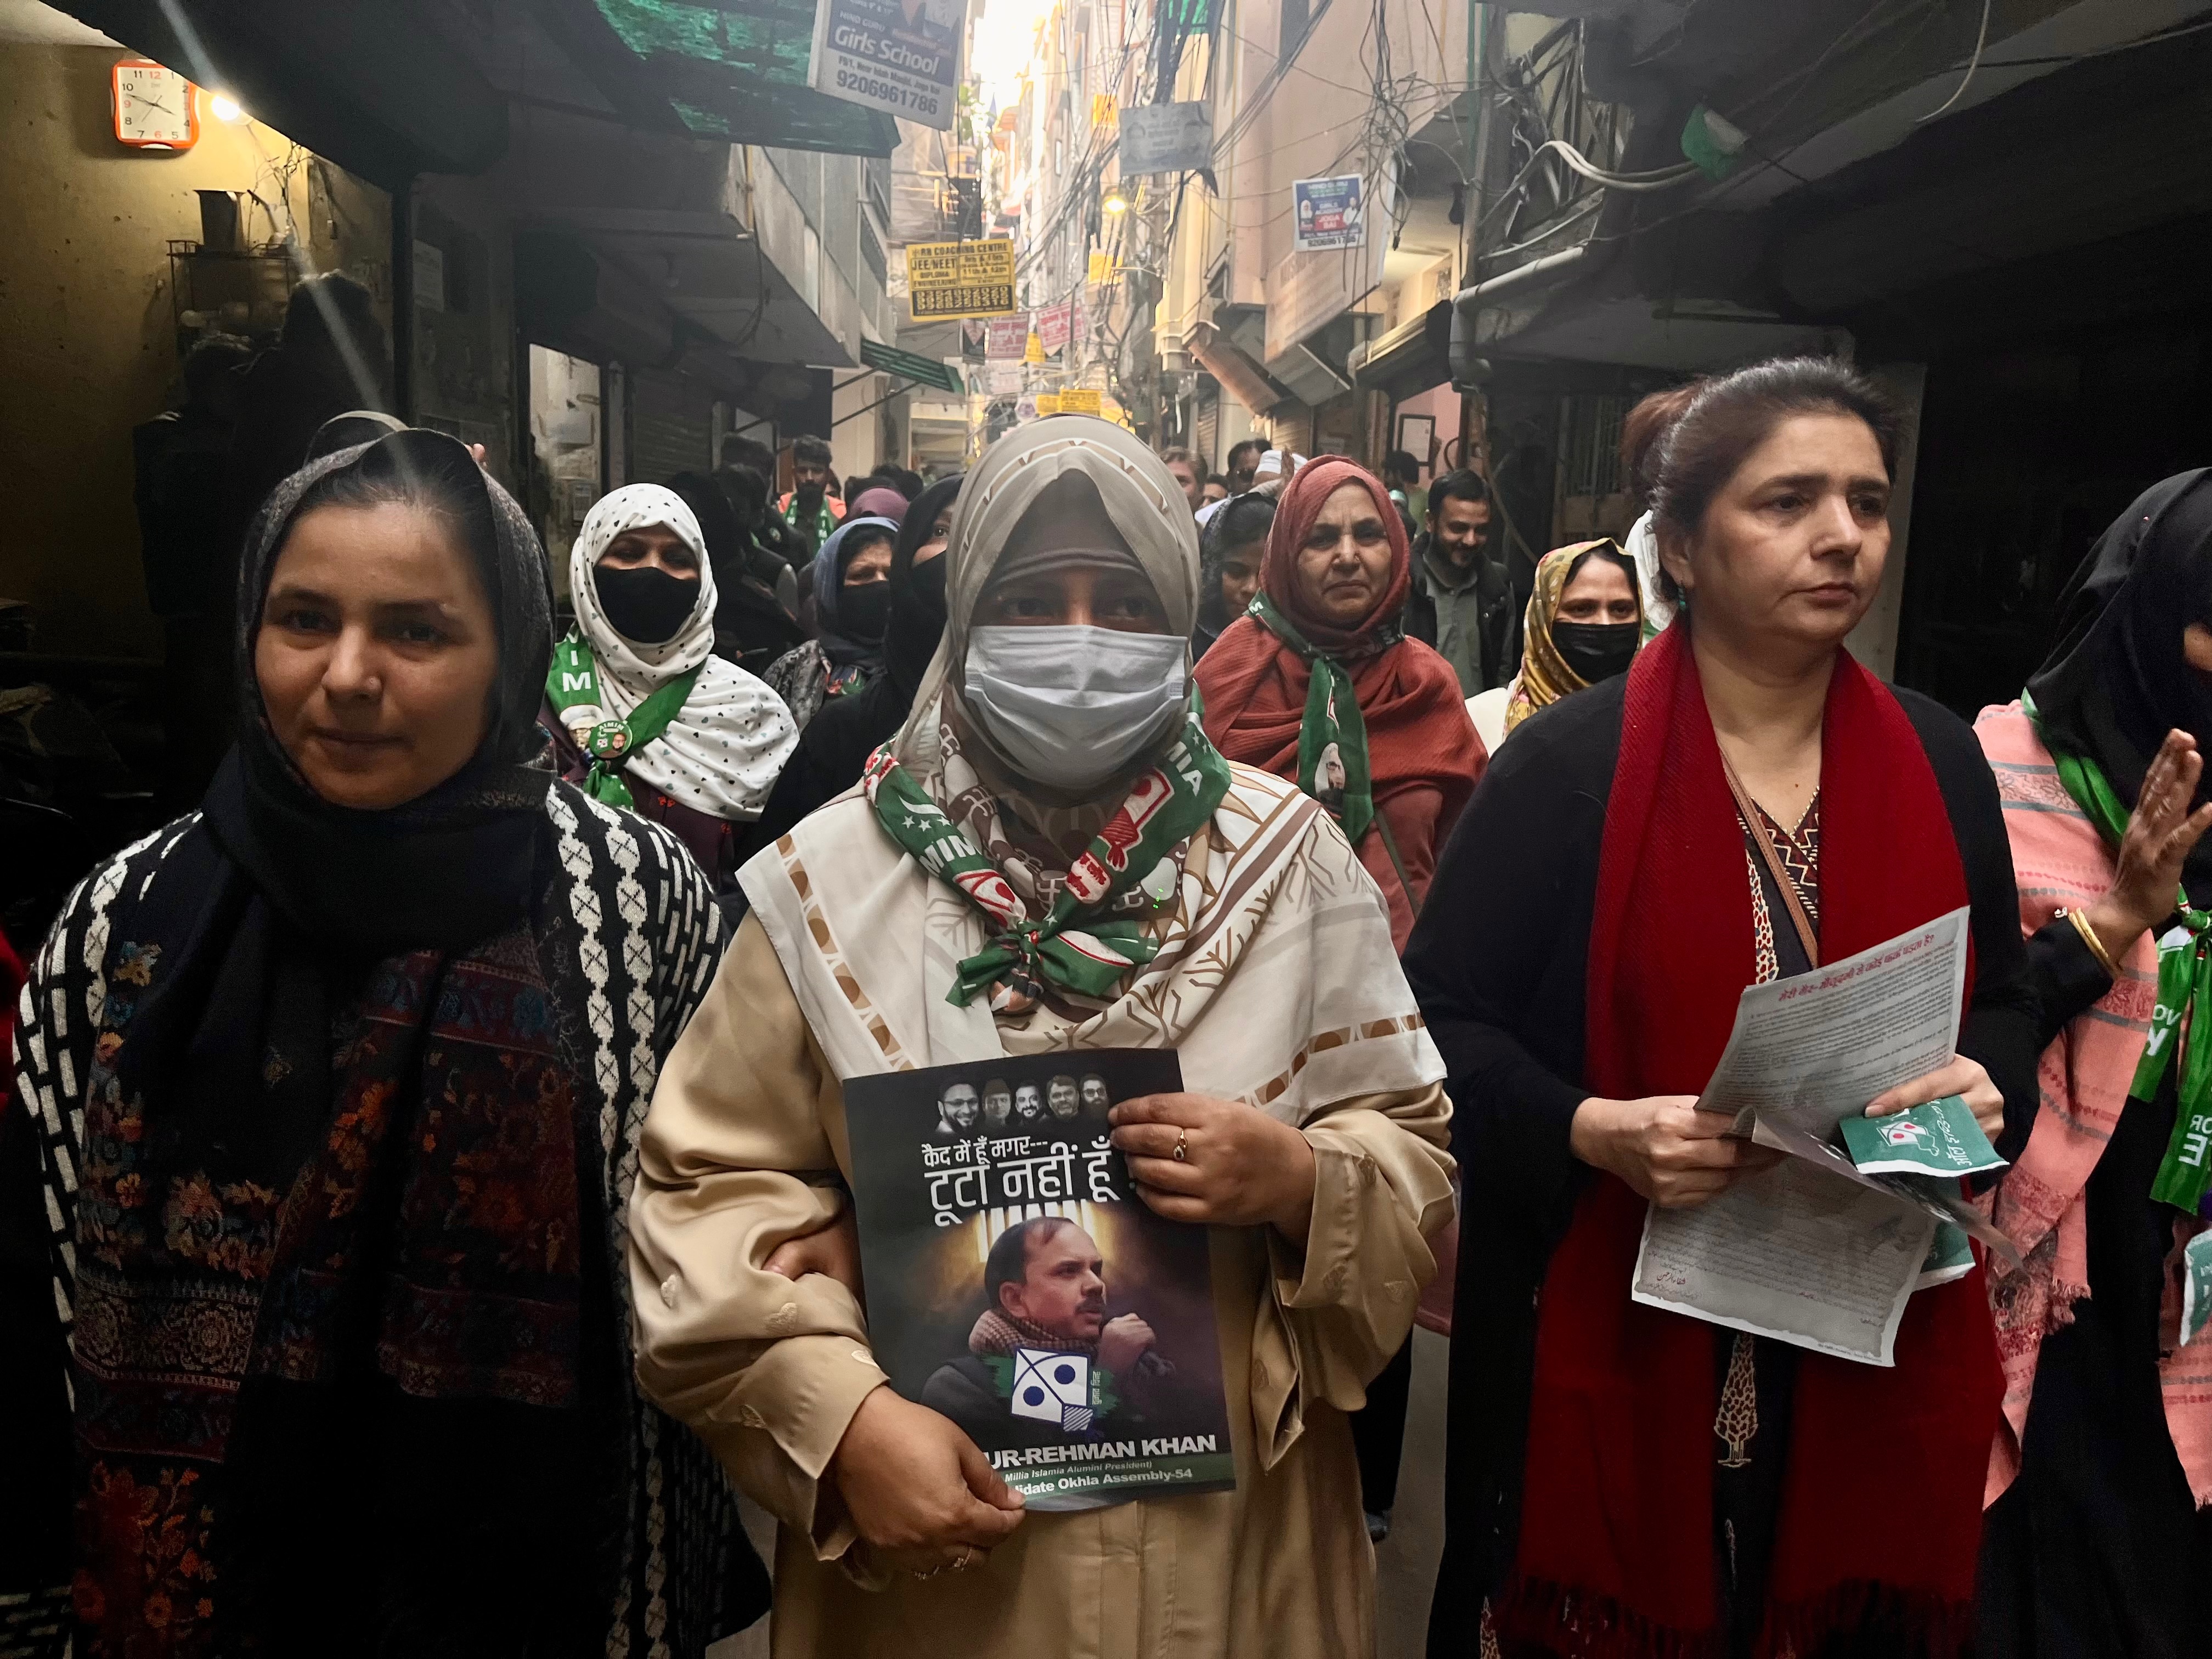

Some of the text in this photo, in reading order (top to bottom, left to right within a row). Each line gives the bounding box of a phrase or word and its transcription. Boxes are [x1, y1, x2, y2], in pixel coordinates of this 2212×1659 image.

[835, 25, 877, 54] Girls
[878, 40, 939, 75] School
[134, 70, 142, 78] 11
[149, 71, 161, 80] 12
[122, 83, 133, 92] 10
[837, 69, 938, 115] 9206961786
[124, 100, 132, 108] 9
[125, 117, 132, 125] 8
[137, 130, 145, 138] 7
[978, 242, 1007, 252] CENTRE
[599, 721, 624, 733] AIMIM
[953, 1138, 971, 1163] में
[973, 1135, 991, 1165] हूँ
[924, 1135, 1121, 1227] टूटा नहीं हूँ
[1141, 1434, 1216, 1457] KHAN
[1005, 1471, 1029, 1482] Millia
[1031, 1465, 1064, 1478] Islamia
[1105, 1460, 1152, 1471] President)
[1058, 1475, 1099, 1490] Okhla
[1103, 1468, 1193, 1484] Assembly-54
